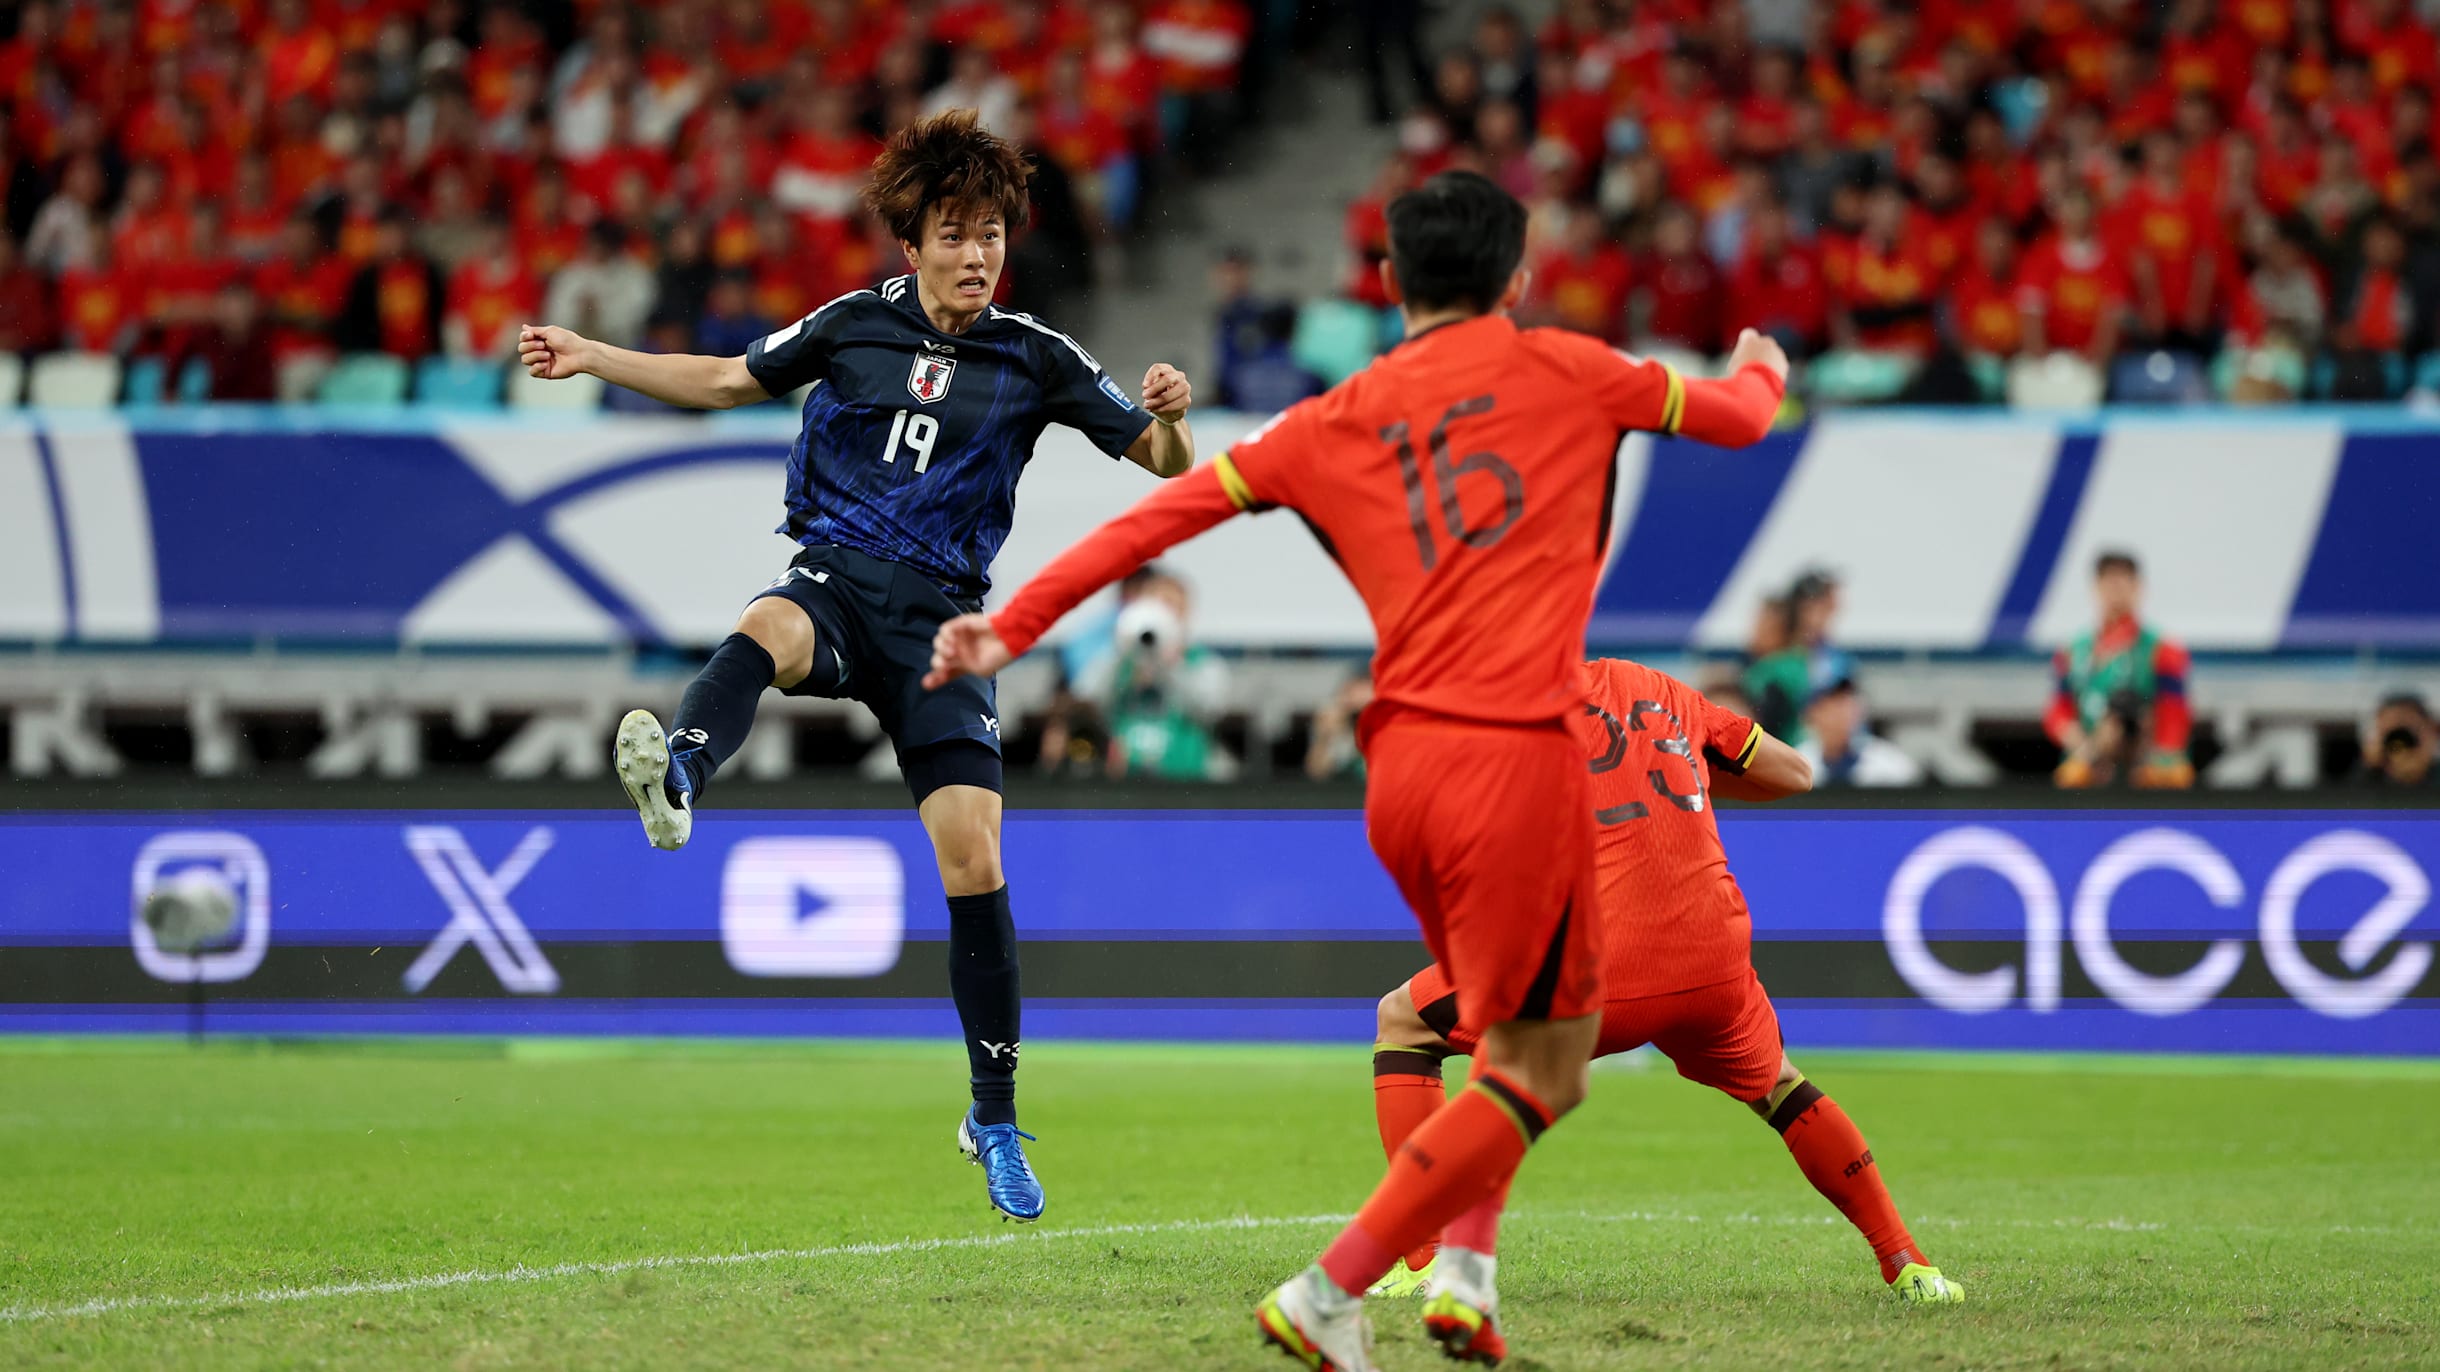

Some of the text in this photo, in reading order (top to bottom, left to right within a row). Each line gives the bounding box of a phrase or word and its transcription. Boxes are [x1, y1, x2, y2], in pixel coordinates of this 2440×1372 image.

[882, 409, 940, 474] 19
[926, 354, 947, 365] JAPAN
[1379, 394, 1525, 572] 16
[402, 826, 562, 994] X
[1881, 825, 2435, 1019] ace
